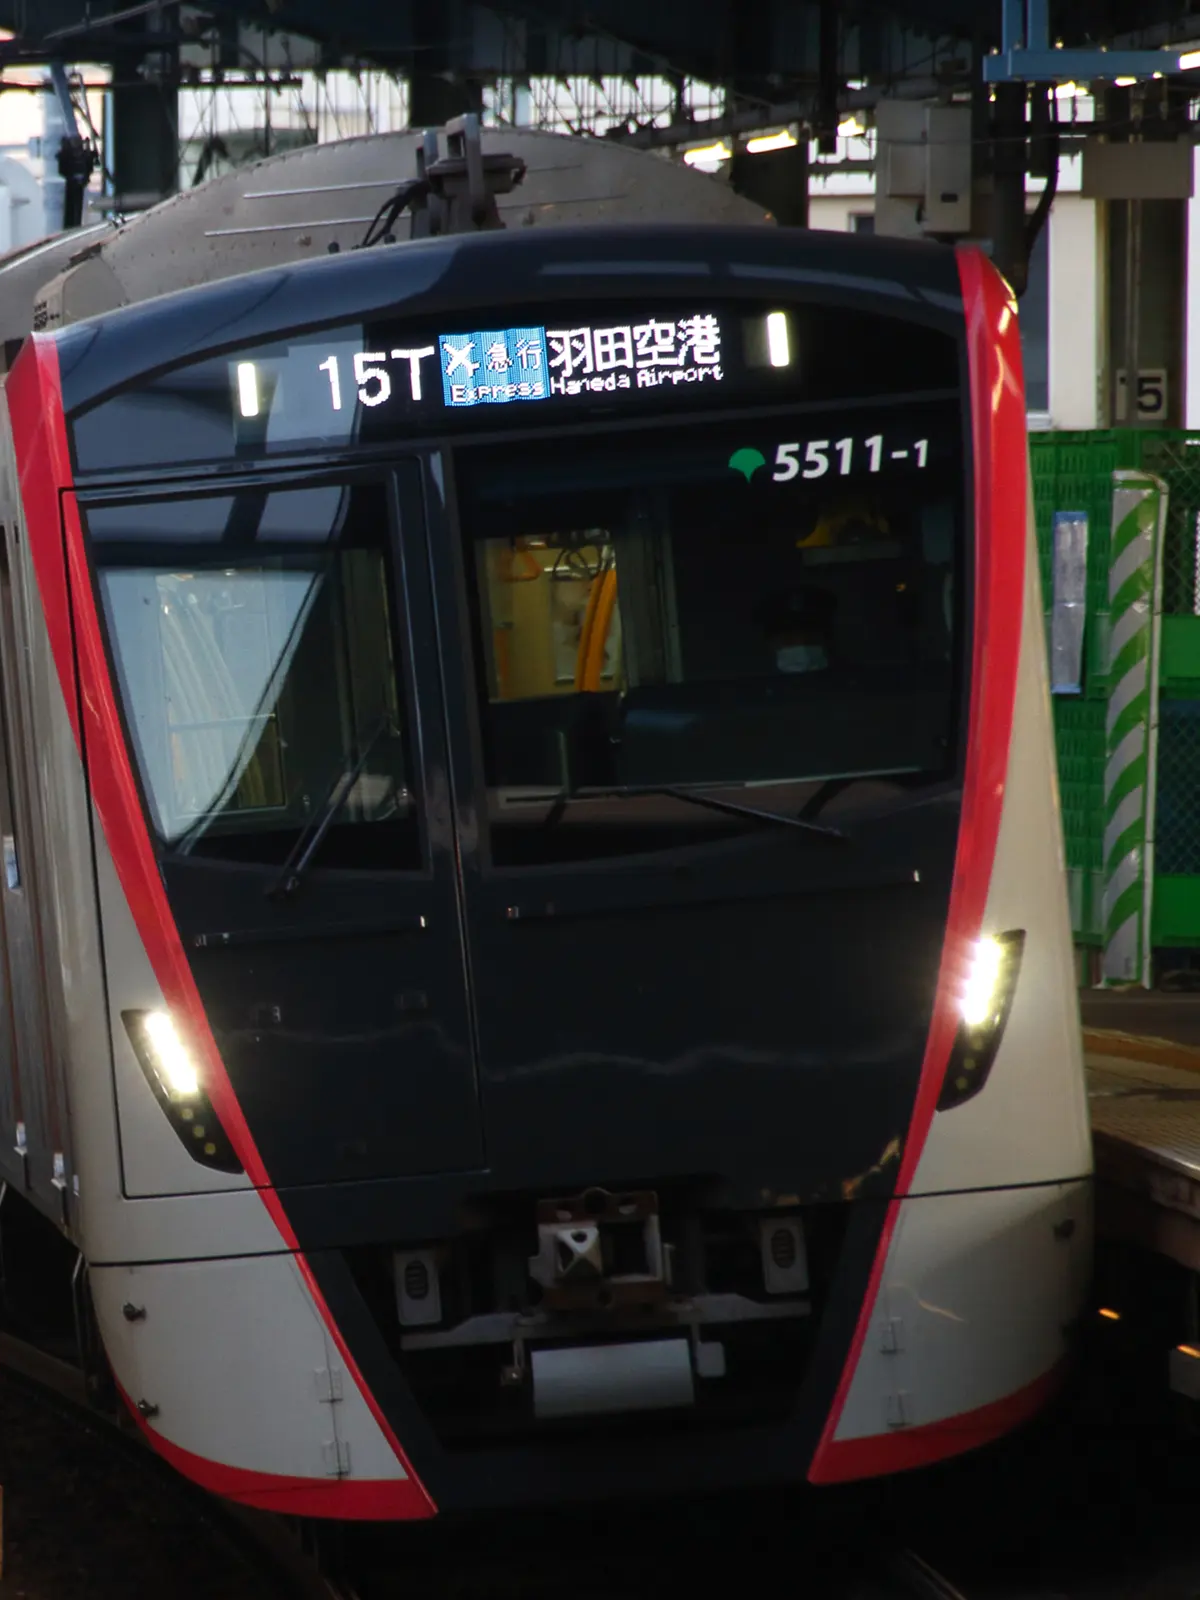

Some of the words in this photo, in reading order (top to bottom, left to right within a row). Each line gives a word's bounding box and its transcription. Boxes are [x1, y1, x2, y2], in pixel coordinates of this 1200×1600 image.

[485, 338, 543, 373] 急行
[546, 314, 721, 377] 羽田空港
[318, 346, 435, 410] 15T
[452, 381, 545, 403] Express
[551, 371, 631, 395] Haneda
[636, 364, 724, 388] Airport
[772, 434, 929, 482] 5511-1
